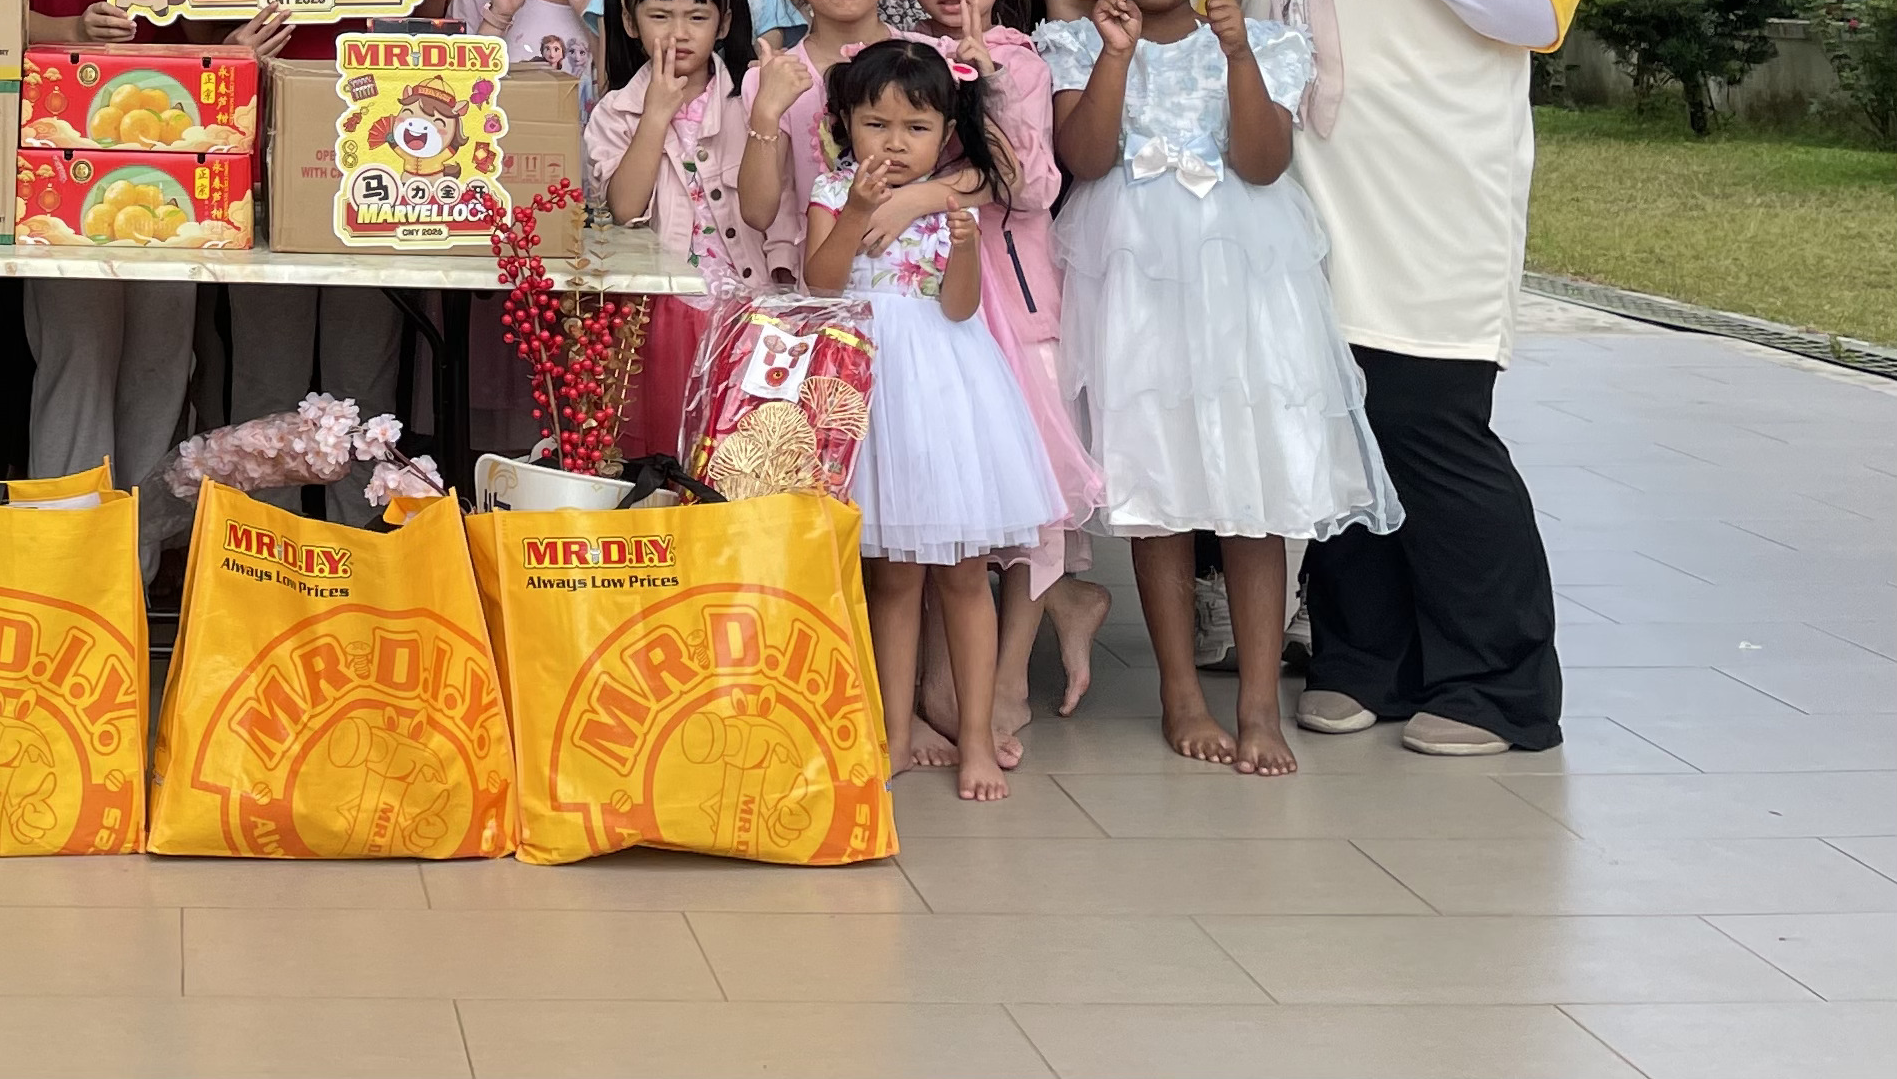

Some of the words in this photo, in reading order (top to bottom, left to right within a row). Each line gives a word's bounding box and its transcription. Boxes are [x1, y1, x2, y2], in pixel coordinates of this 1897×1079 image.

[316, 150, 336, 161] OPE
[301, 166, 328, 179] WITH
[401, 228, 420, 237] CNY
[221, 557, 272, 582] Always
[298, 582, 350, 599] Prices
[525, 574, 588, 592] Always
[591, 575, 624, 588] Low
[628, 573, 679, 587] Prices
